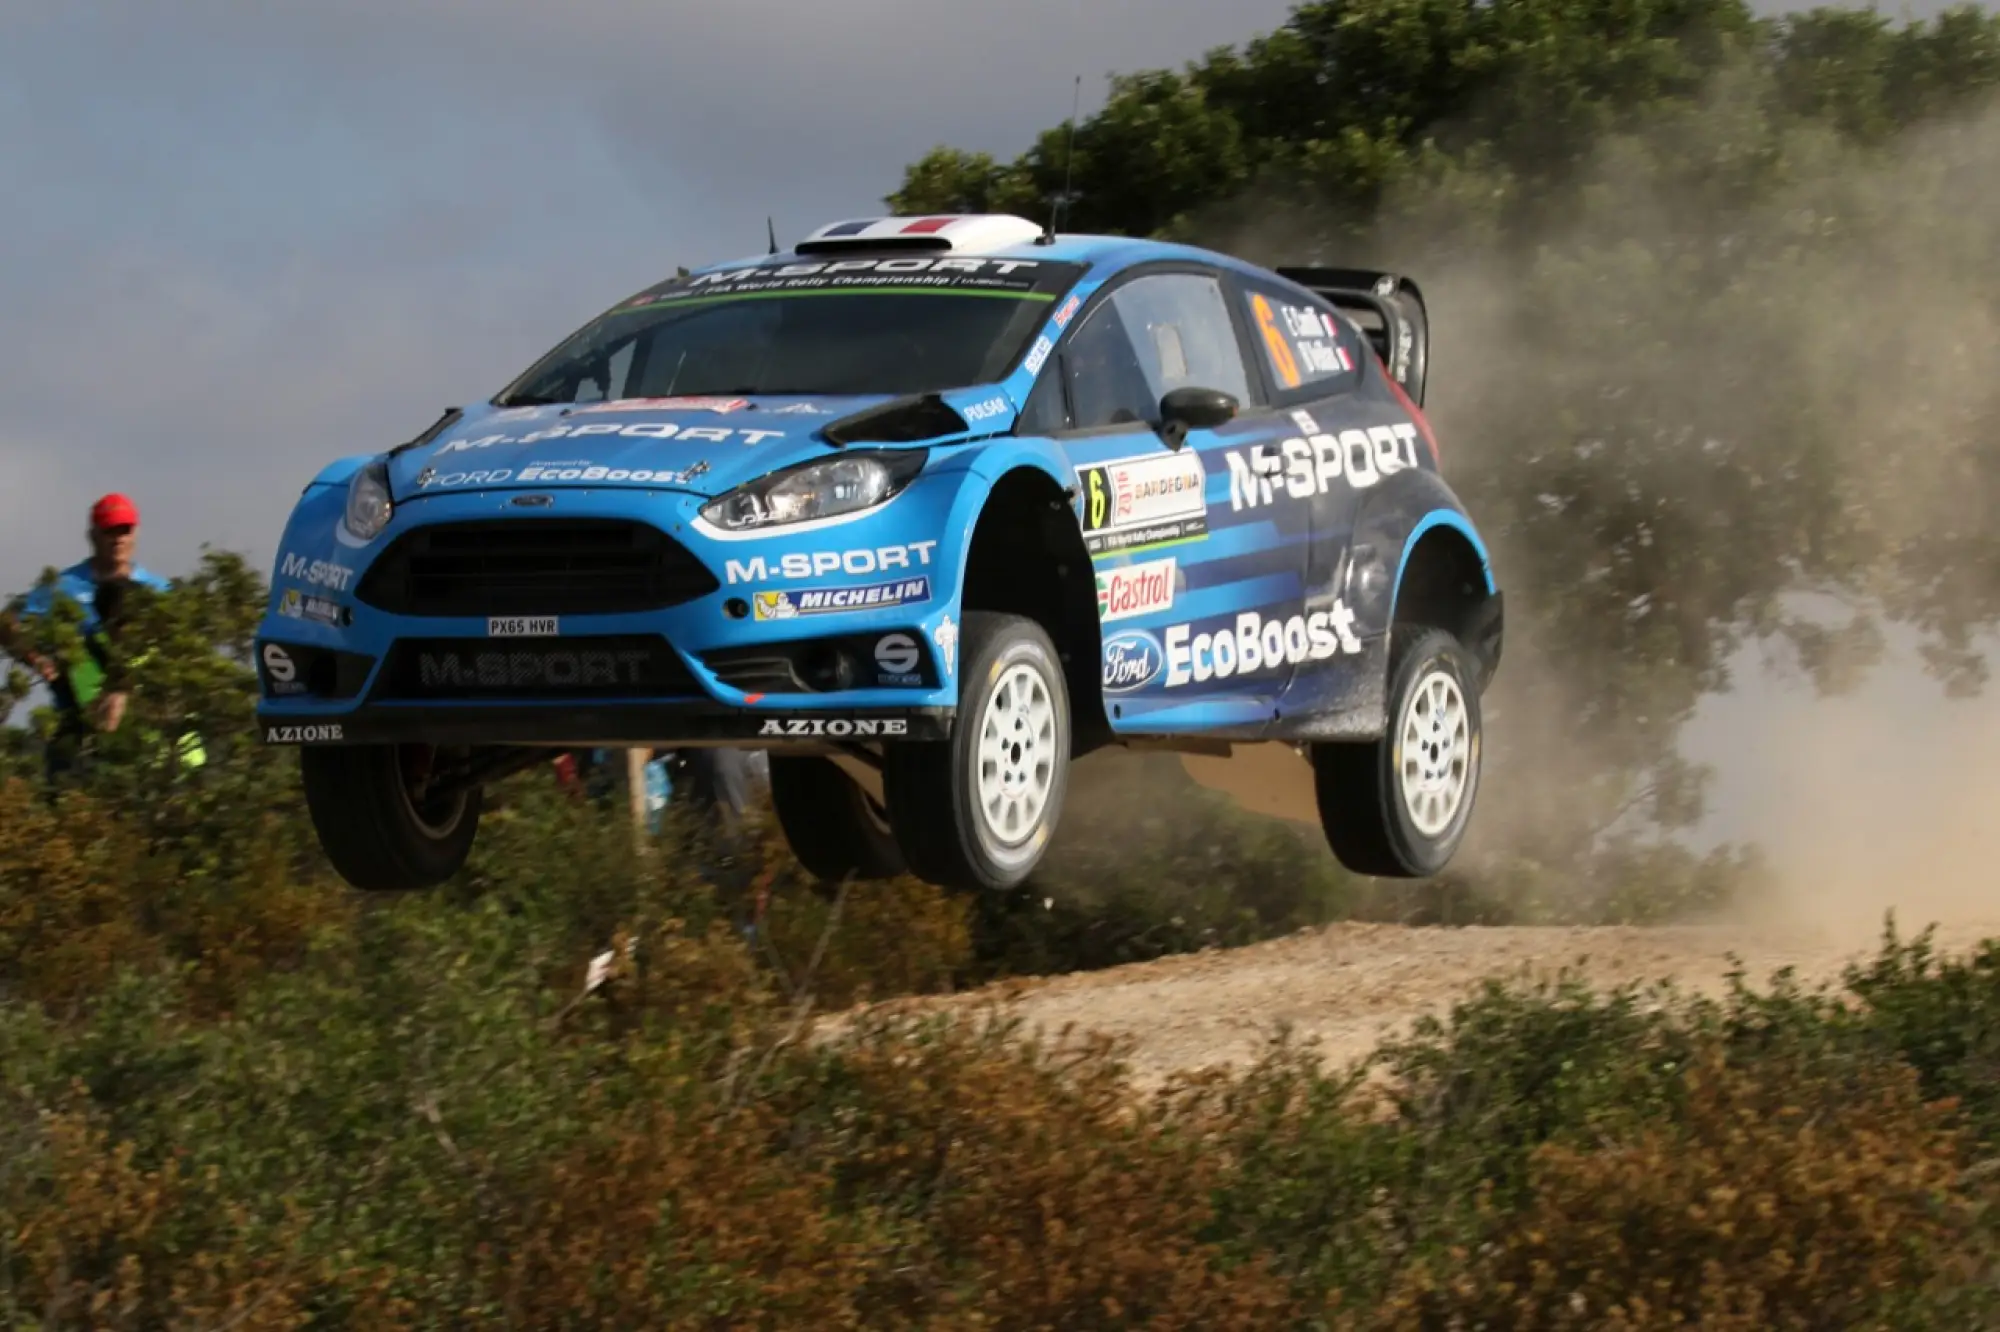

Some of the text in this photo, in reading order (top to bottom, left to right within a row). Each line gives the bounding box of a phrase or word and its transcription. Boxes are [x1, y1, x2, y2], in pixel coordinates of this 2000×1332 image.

[689, 258, 1039, 287] M-SPORT
[786, 278, 829, 288] Rally
[832, 275, 949, 286] Championship
[1252, 294, 1299, 388] 6
[433, 423, 784, 456] M-SPORT
[1225, 423, 1418, 511] M-SPORT
[1089, 468, 1105, 529] 6
[281, 552, 353, 591] M-SPORT
[725, 540, 937, 584] M-SPORT
[800, 580, 924, 609] MICHELIN
[1110, 566, 1169, 613] Castrol
[491, 619, 556, 634] PX65 HVR
[1164, 597, 1361, 687] EcoBoost
[418, 651, 651, 686] M-SPORT
[1103, 641, 1151, 685] Ford
[267, 724, 343, 743] AZIONE
[758, 719, 907, 735] AZIONE
